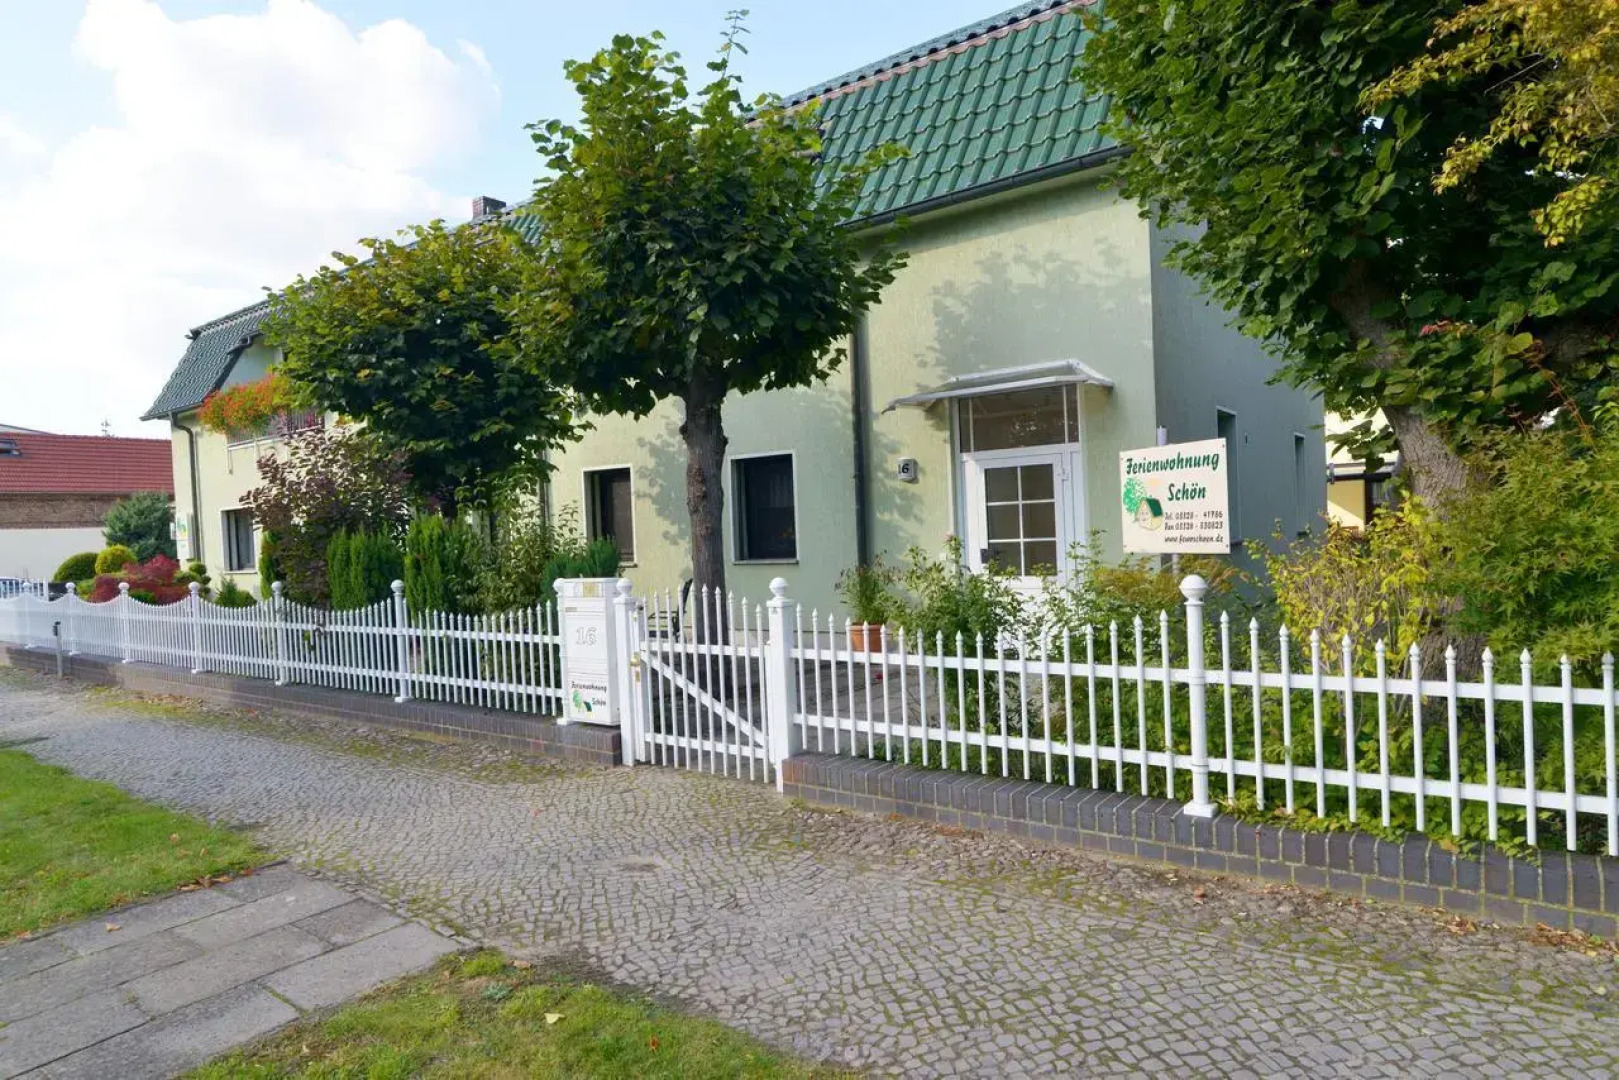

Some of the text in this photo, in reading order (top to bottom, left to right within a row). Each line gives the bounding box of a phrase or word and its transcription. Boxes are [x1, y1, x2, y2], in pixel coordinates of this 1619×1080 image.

[1126, 452, 1219, 475] Ferienwohnung
[1168, 482, 1206, 502] Schön
[576, 626, 597, 646] 16
